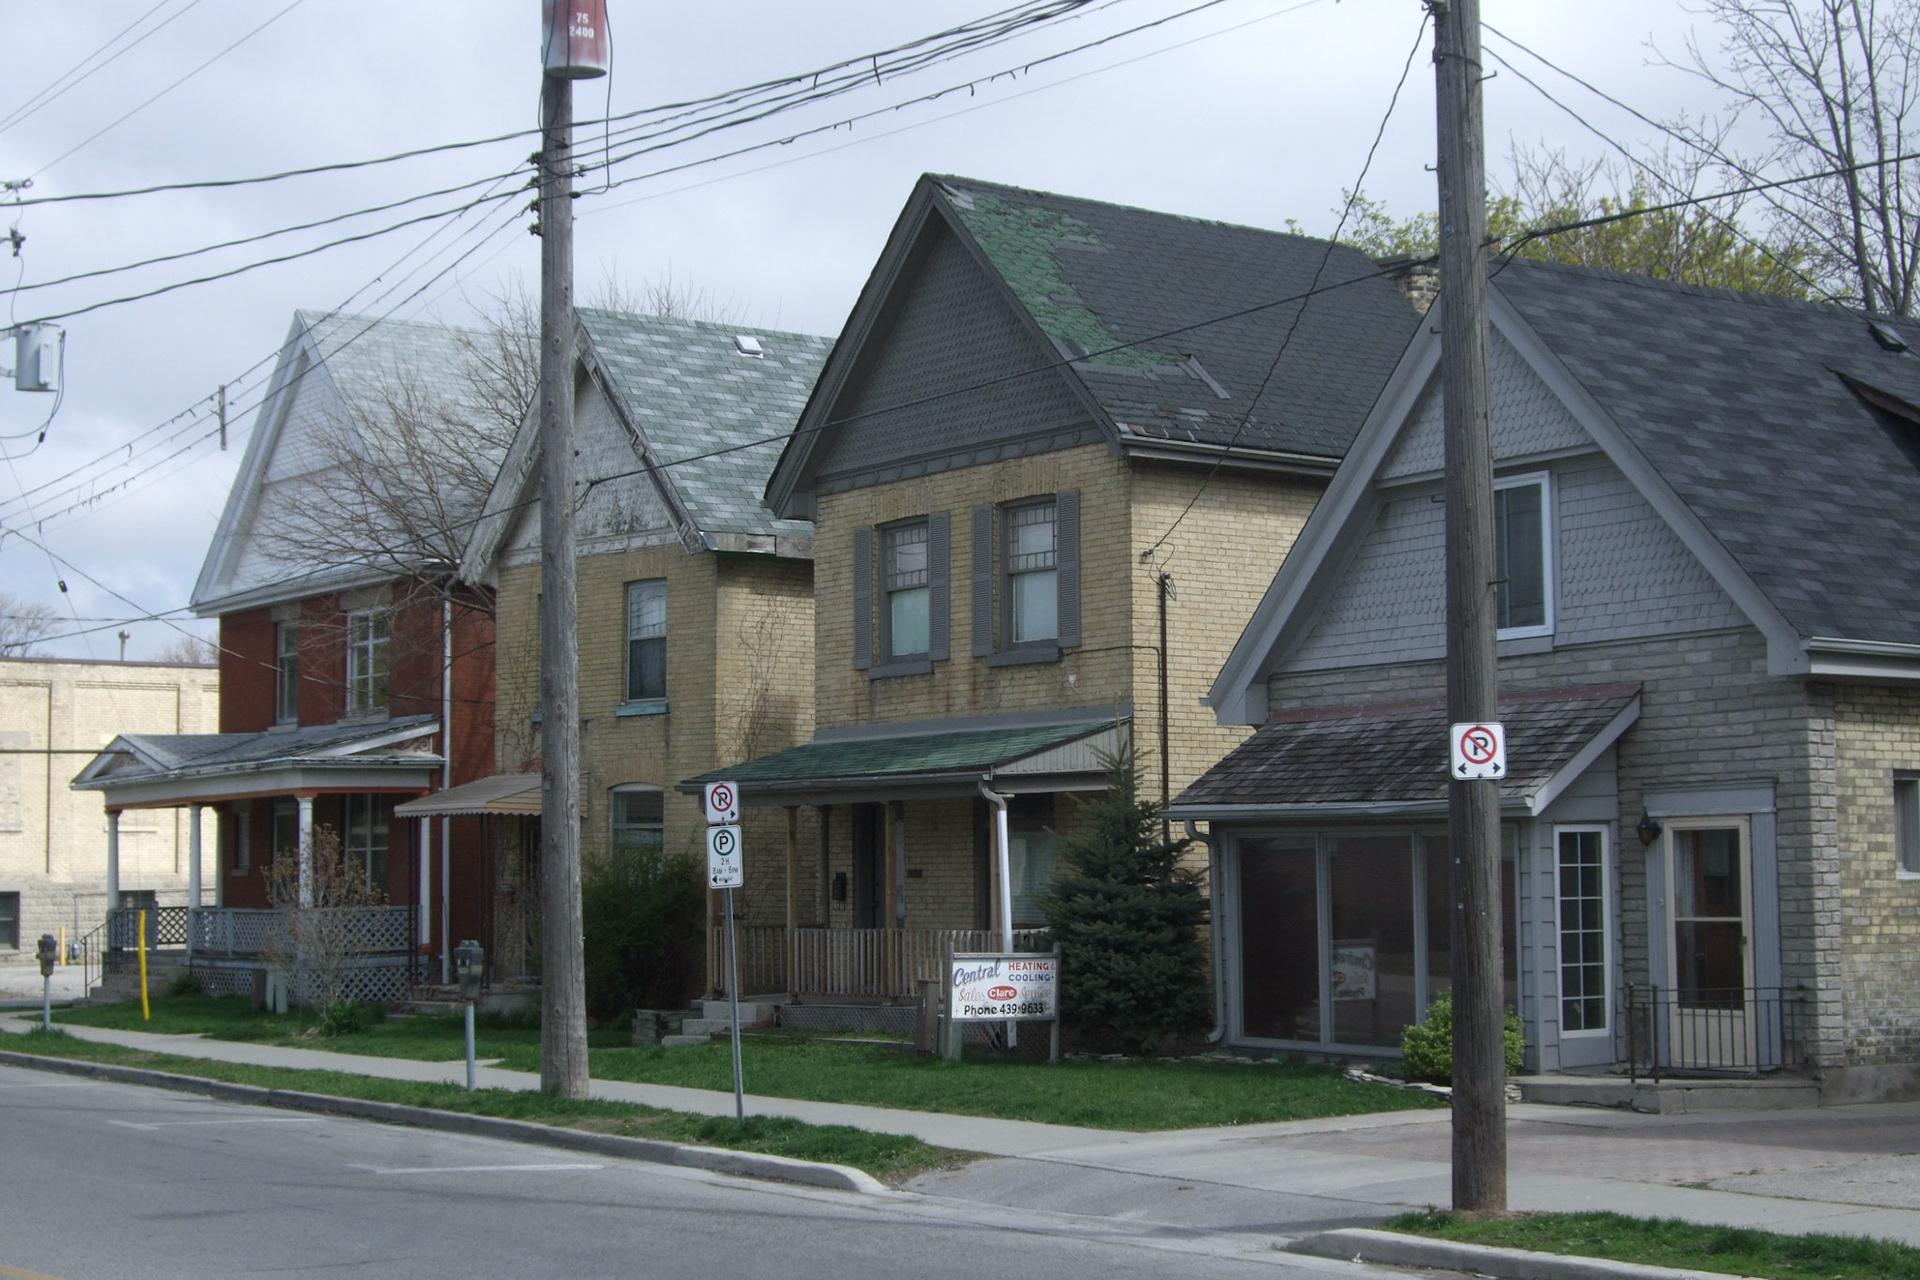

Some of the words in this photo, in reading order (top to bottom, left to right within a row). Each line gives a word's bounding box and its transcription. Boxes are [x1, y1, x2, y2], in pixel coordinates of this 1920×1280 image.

[576, 12, 589, 24] 75
[569, 25, 595, 39] 2400
[719, 835, 729, 850] P
[953, 958, 1001, 987] Central
[1008, 962, 1049, 971] HEATING
[1008, 974, 1051, 982] COOLING
[959, 987, 985, 1002] Sales
[988, 988, 1015, 998] Clare
[964, 1004, 998, 1016] Phone
